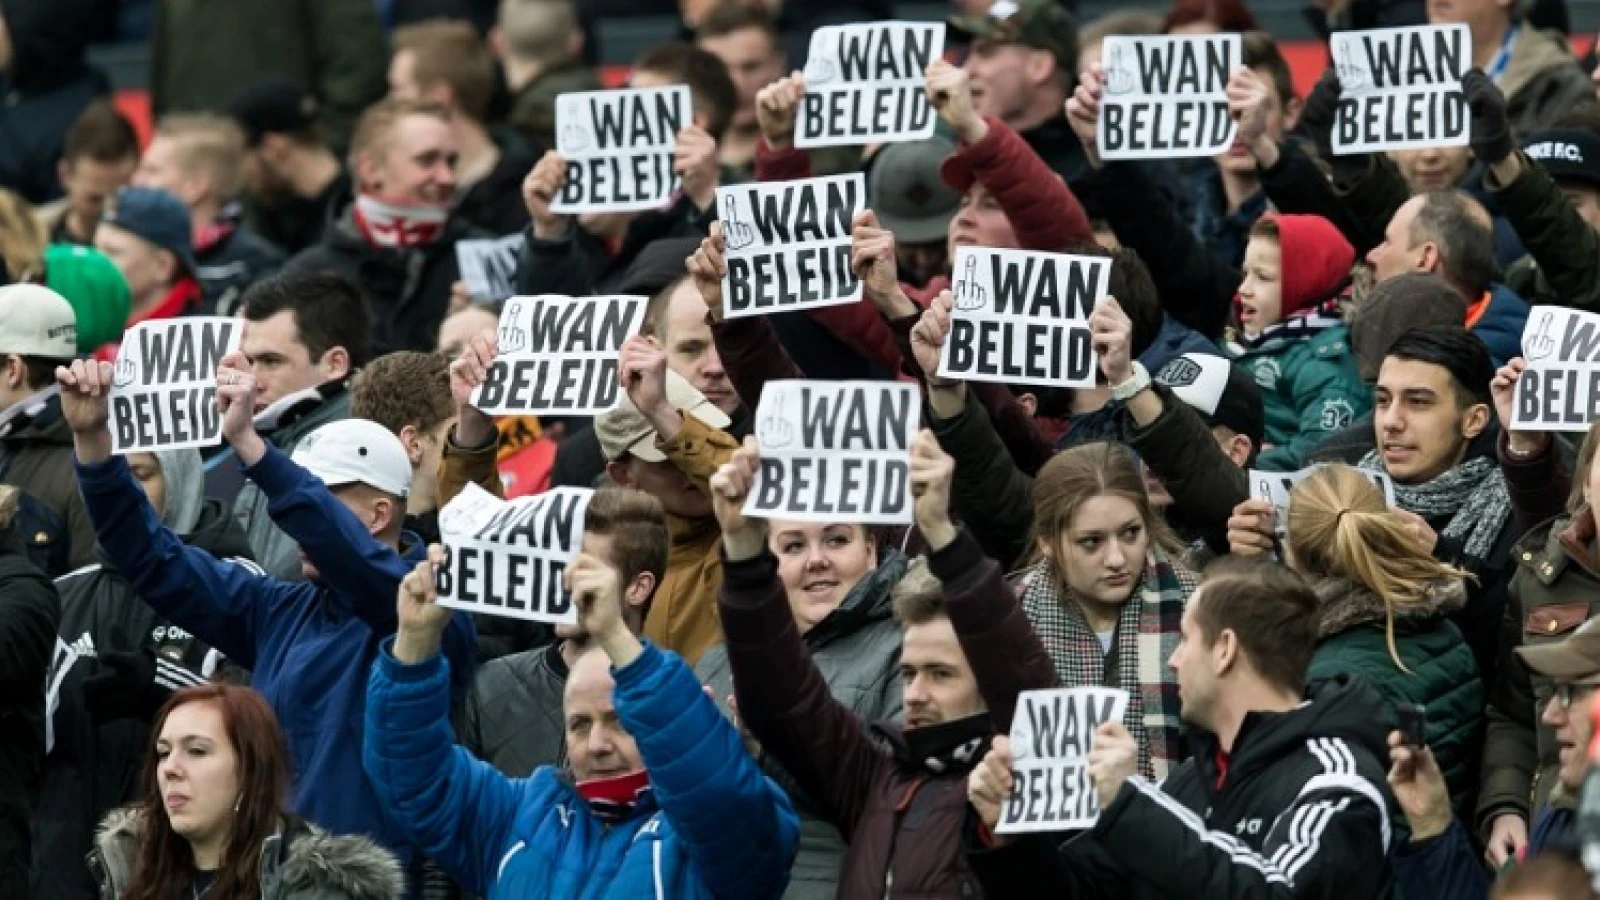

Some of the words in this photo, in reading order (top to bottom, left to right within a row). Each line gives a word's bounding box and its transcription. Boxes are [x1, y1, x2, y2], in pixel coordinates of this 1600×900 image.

[838, 27, 934, 82] WAN
[1134, 40, 1231, 95] WAN
[1363, 29, 1462, 88] WAN
[589, 91, 681, 149] WAN
[803, 87, 931, 140] BELEID
[1103, 101, 1232, 151] BELEID
[1338, 91, 1466, 146] BELEID
[748, 179, 857, 246] WAN
[727, 245, 859, 311] BELEID
[990, 253, 1102, 320] WAN
[139, 322, 233, 386] WAN
[532, 299, 639, 353] WAN
[947, 318, 1092, 381] BELEID
[477, 358, 620, 409] BELEID
[113, 387, 220, 449] BELEID
[801, 387, 911, 450] WAN
[755, 457, 909, 514] BELEID
[436, 544, 572, 615] BELEID
